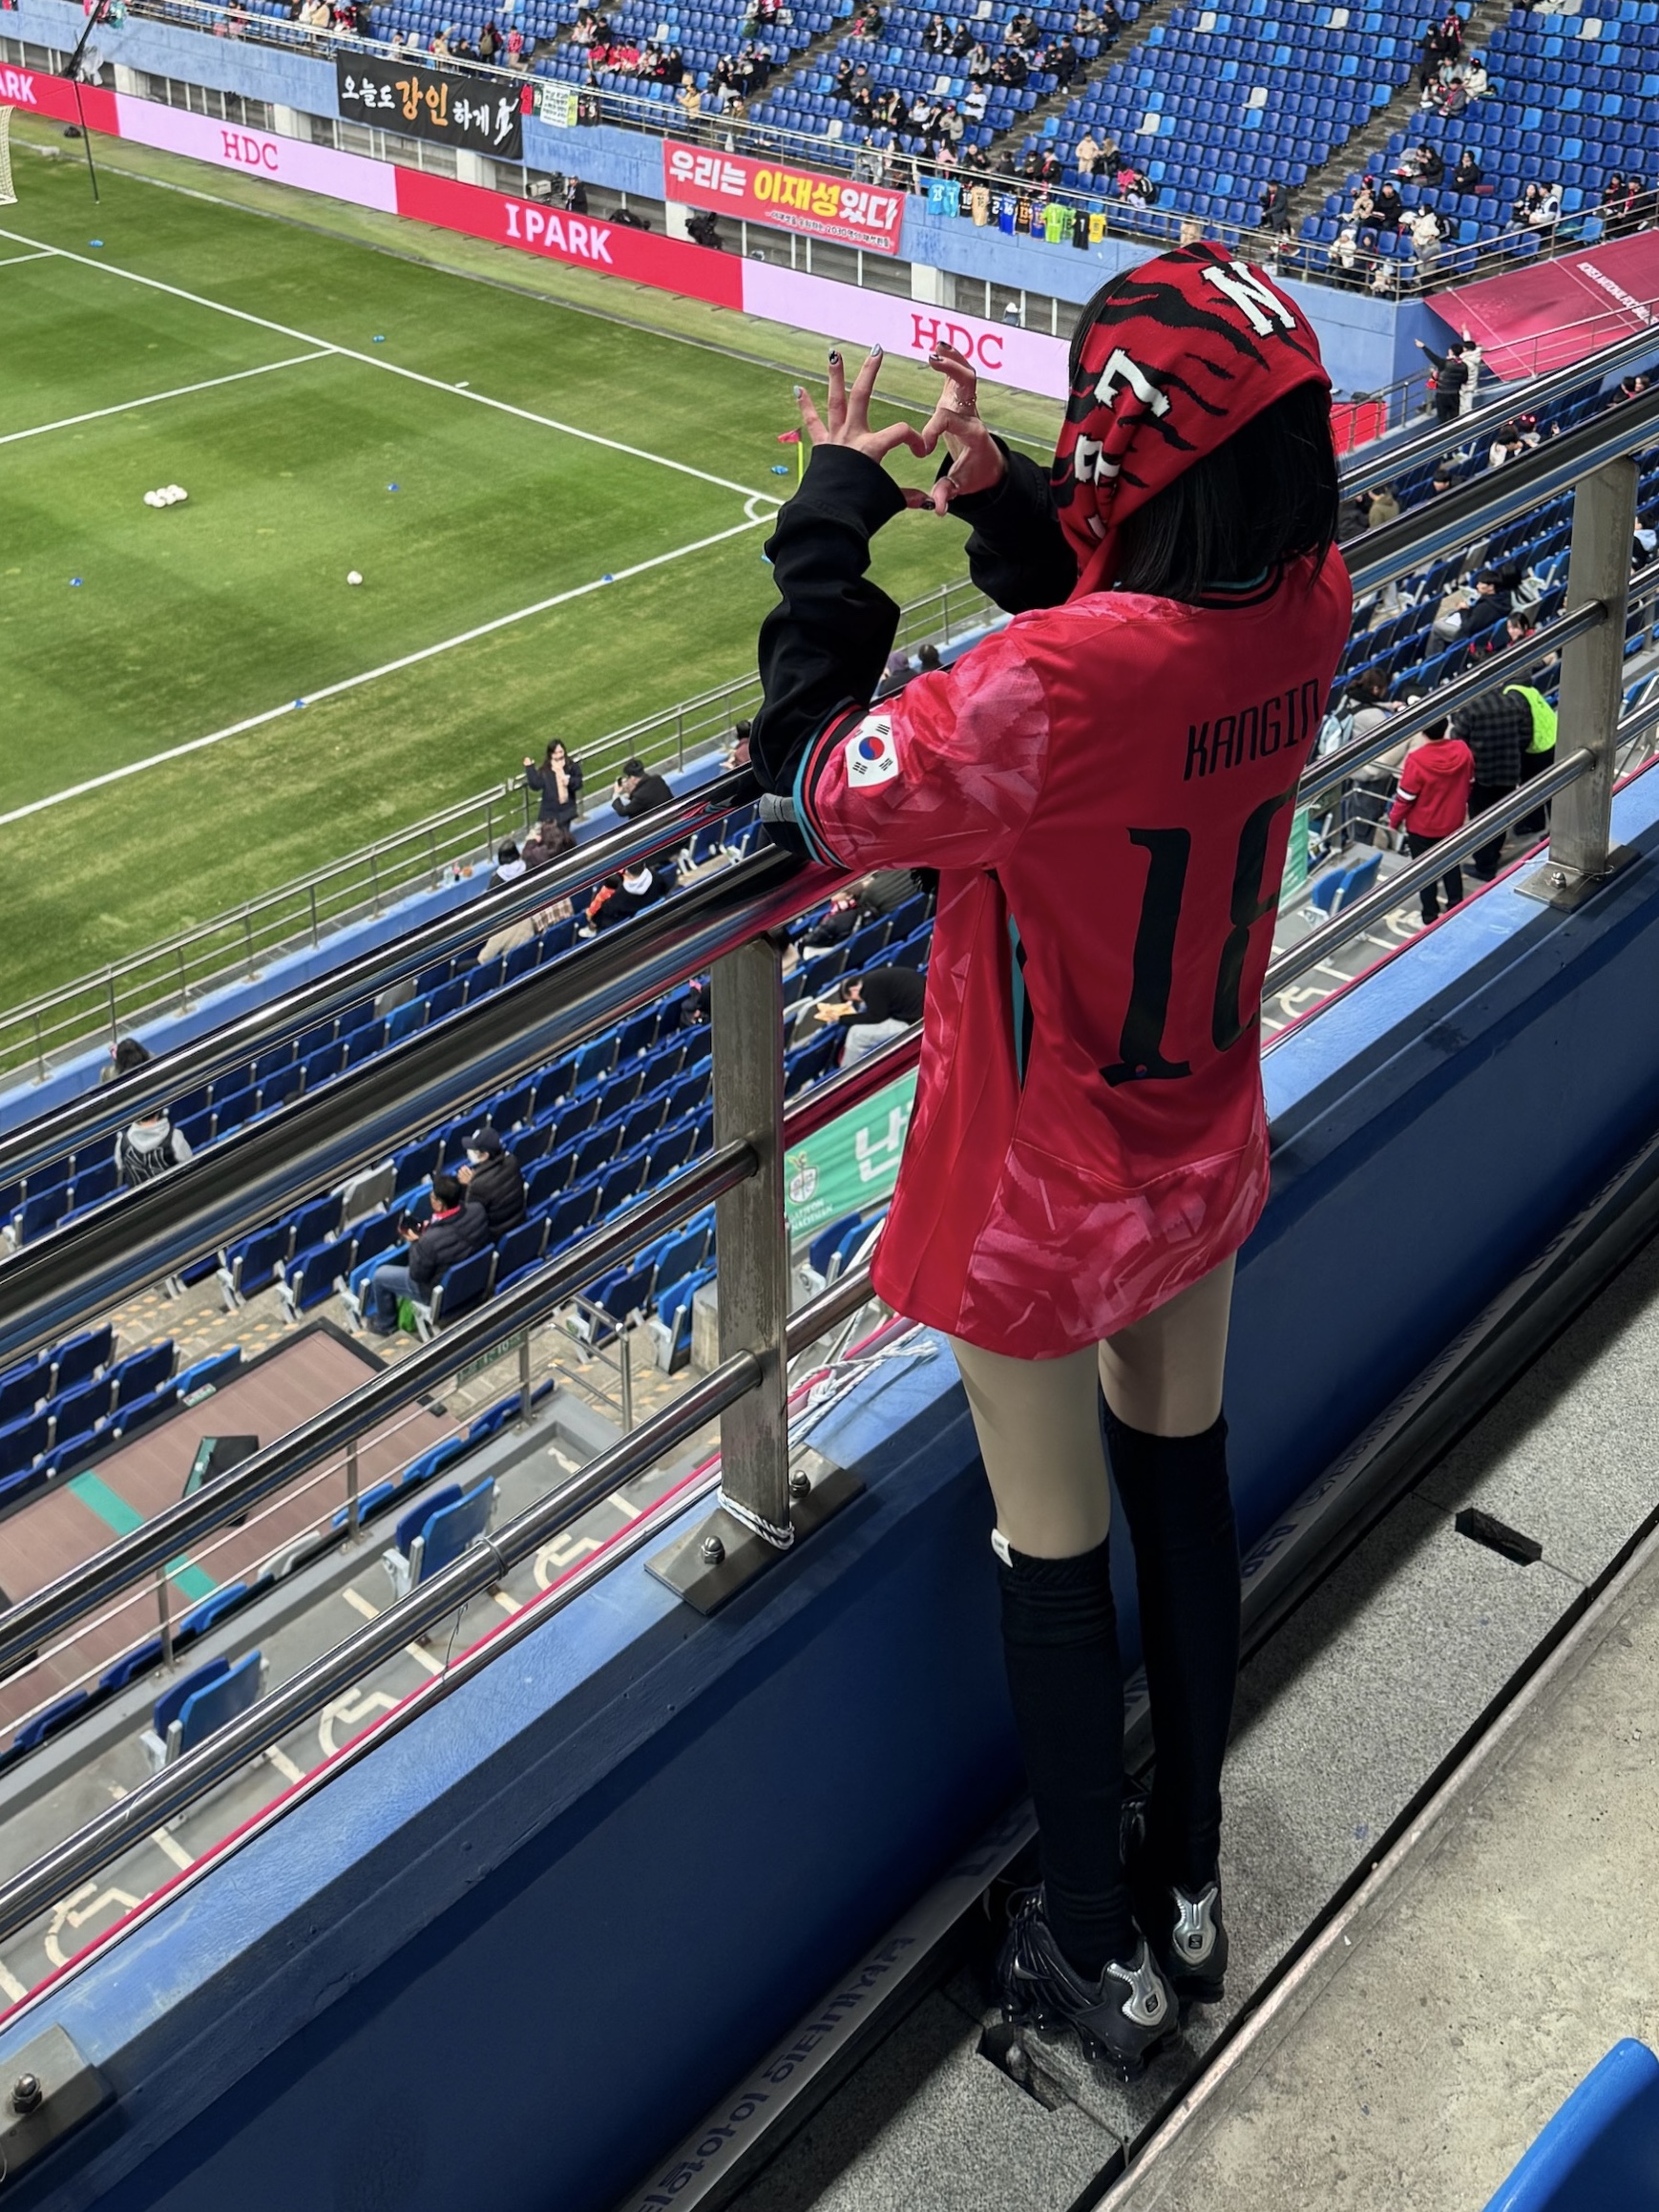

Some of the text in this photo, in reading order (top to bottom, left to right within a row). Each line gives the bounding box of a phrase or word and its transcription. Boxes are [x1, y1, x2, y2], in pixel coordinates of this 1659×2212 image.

[342, 75, 395, 109] 오늘도
[220, 130, 279, 171] HDC
[669, 150, 898, 230] 우리는 이재성있다
[1080, 219, 1085, 232] 1
[1201, 261, 1296, 337] N
[911, 313, 1003, 369] HDC
[1183, 677, 1319, 781] KANGIN
